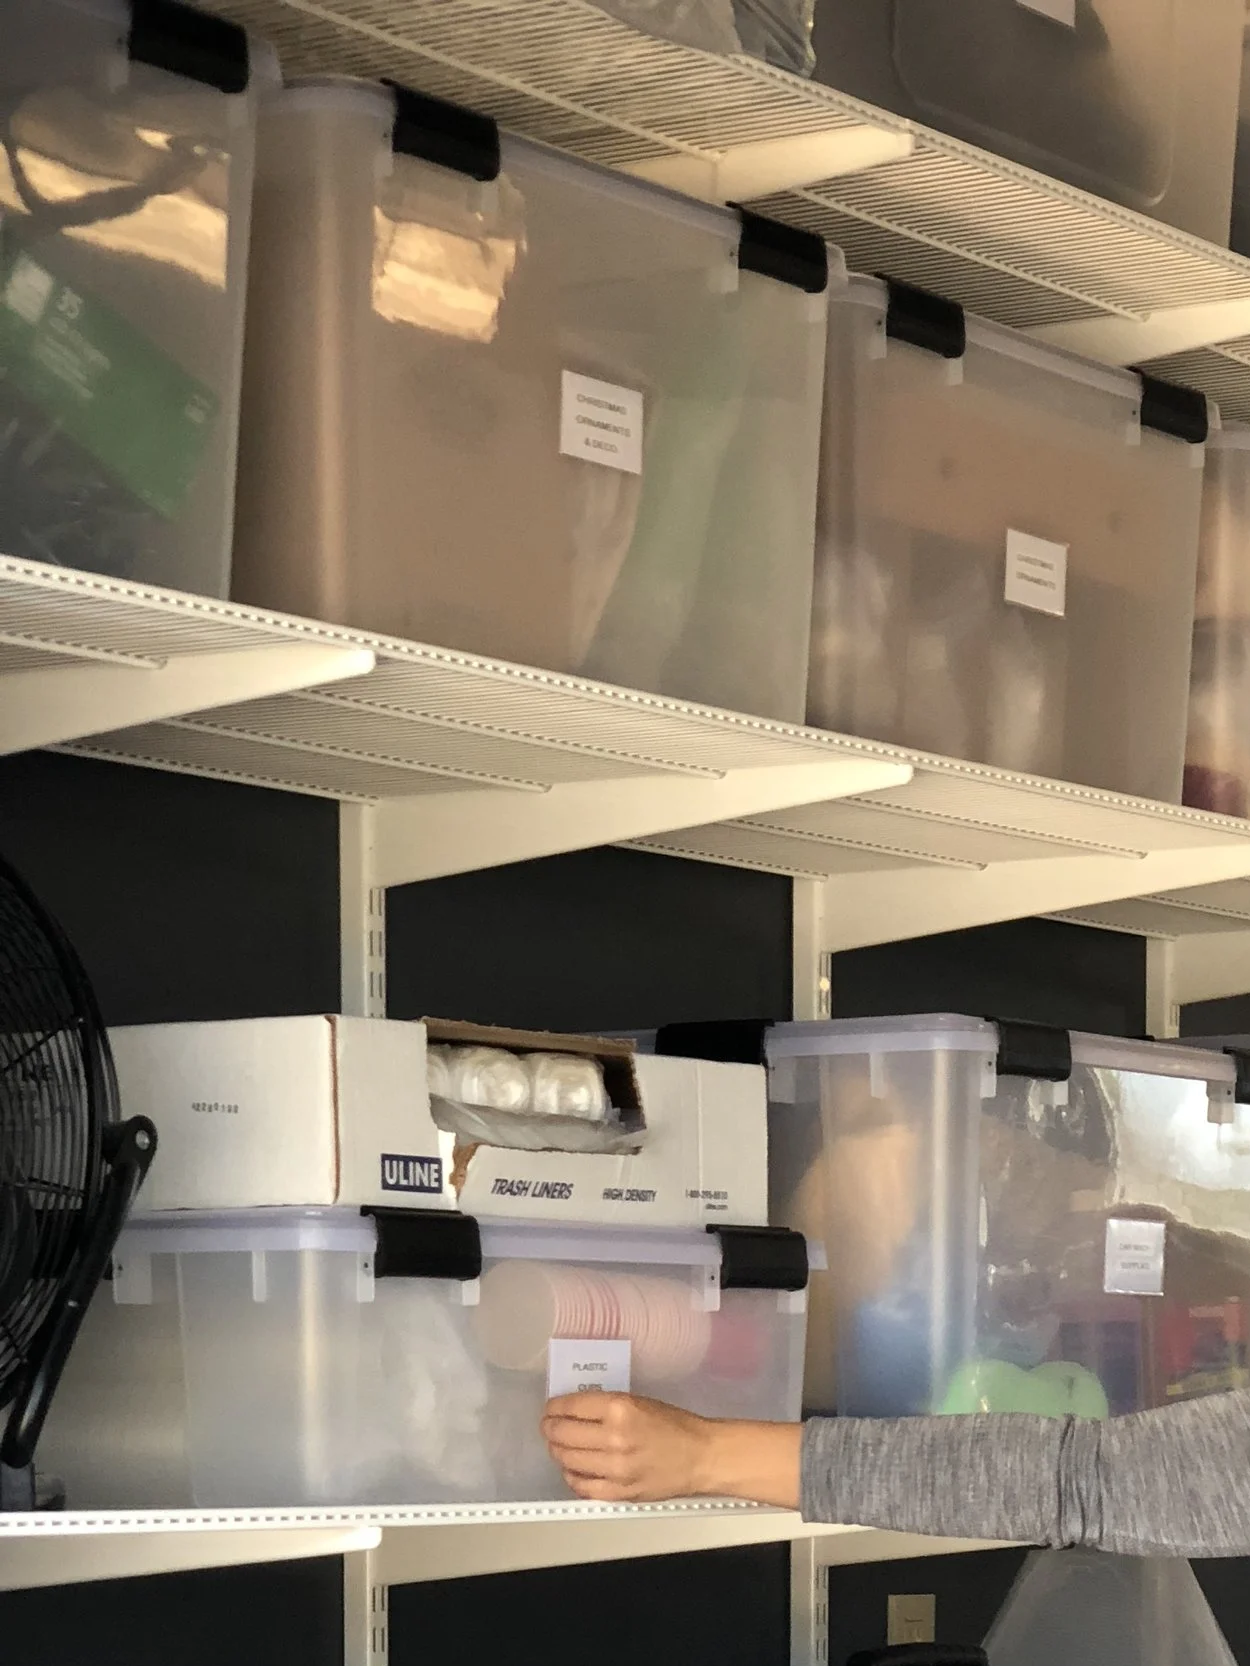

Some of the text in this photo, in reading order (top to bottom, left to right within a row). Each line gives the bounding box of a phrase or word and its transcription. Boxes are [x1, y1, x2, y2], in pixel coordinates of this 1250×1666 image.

[576, 393, 627, 415] CHRISTMAS
[575, 414, 631, 438] ORNAMENTS
[384, 1159, 439, 1188] ULINE
[491, 1178, 574, 1200] TRASH LINERS
[602, 1188, 657, 1202] HIGH DENSITY
[572, 1362, 608, 1372] PLASTIC
